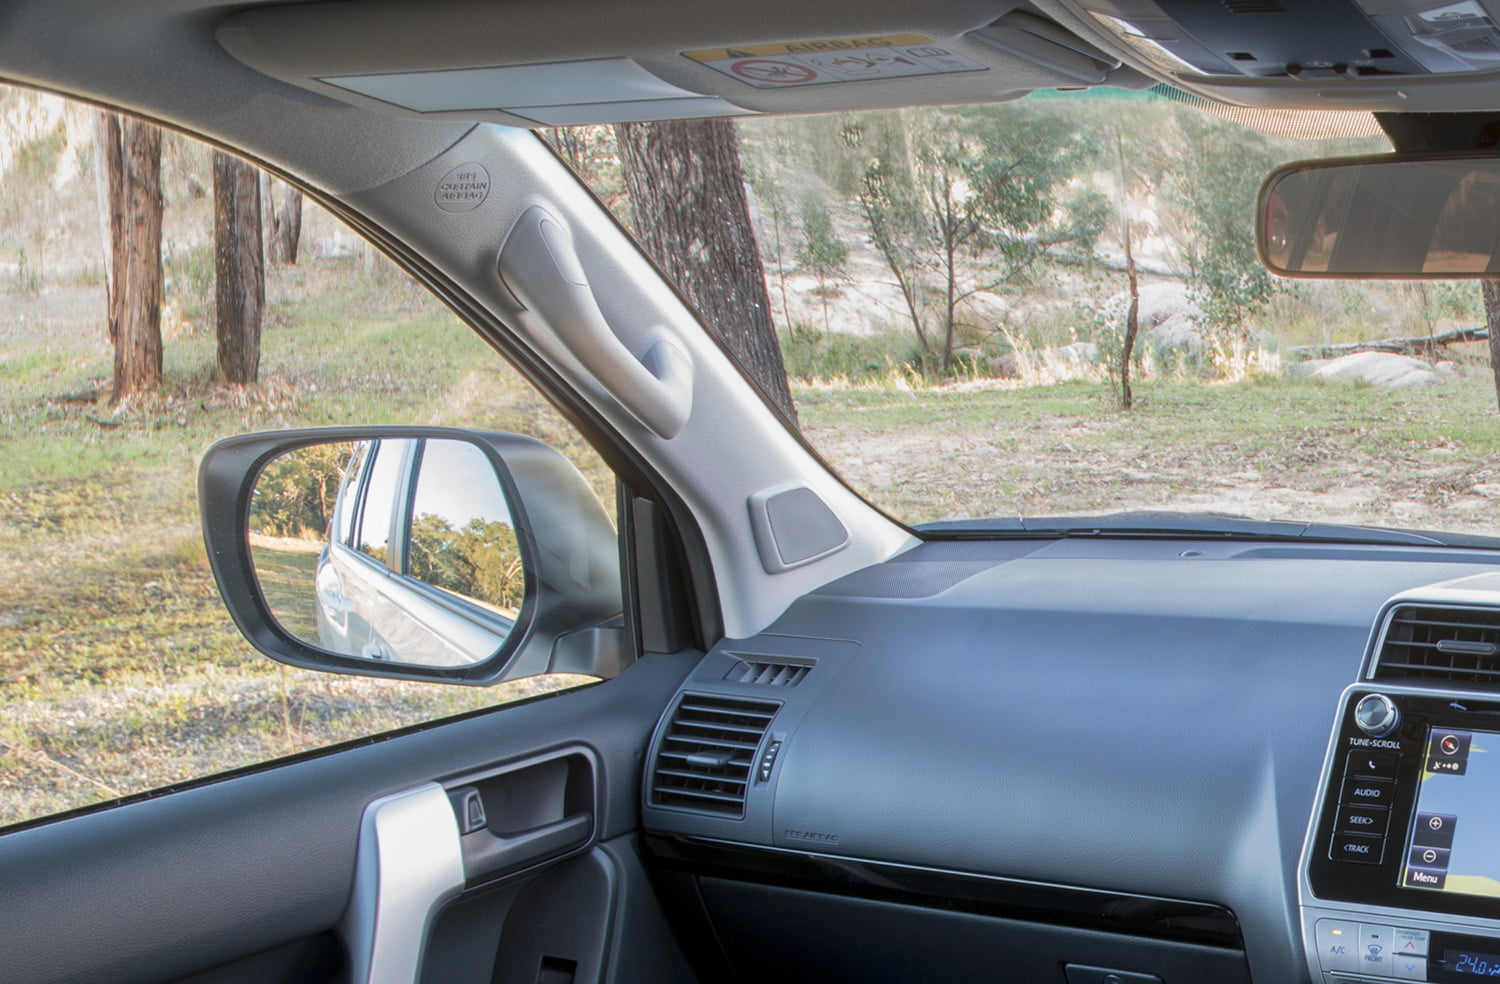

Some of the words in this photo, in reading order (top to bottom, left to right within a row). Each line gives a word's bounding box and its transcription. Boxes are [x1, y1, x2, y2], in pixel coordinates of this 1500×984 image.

[784, 38, 891, 52] AIRBAG
[1354, 788, 1381, 798] AUDIO
[1413, 871, 1438, 884] Menu
[1330, 945, 1345, 955] A/C
[1364, 954, 1383, 962] FRONT
[1455, 954, 1487, 975] 24.0
